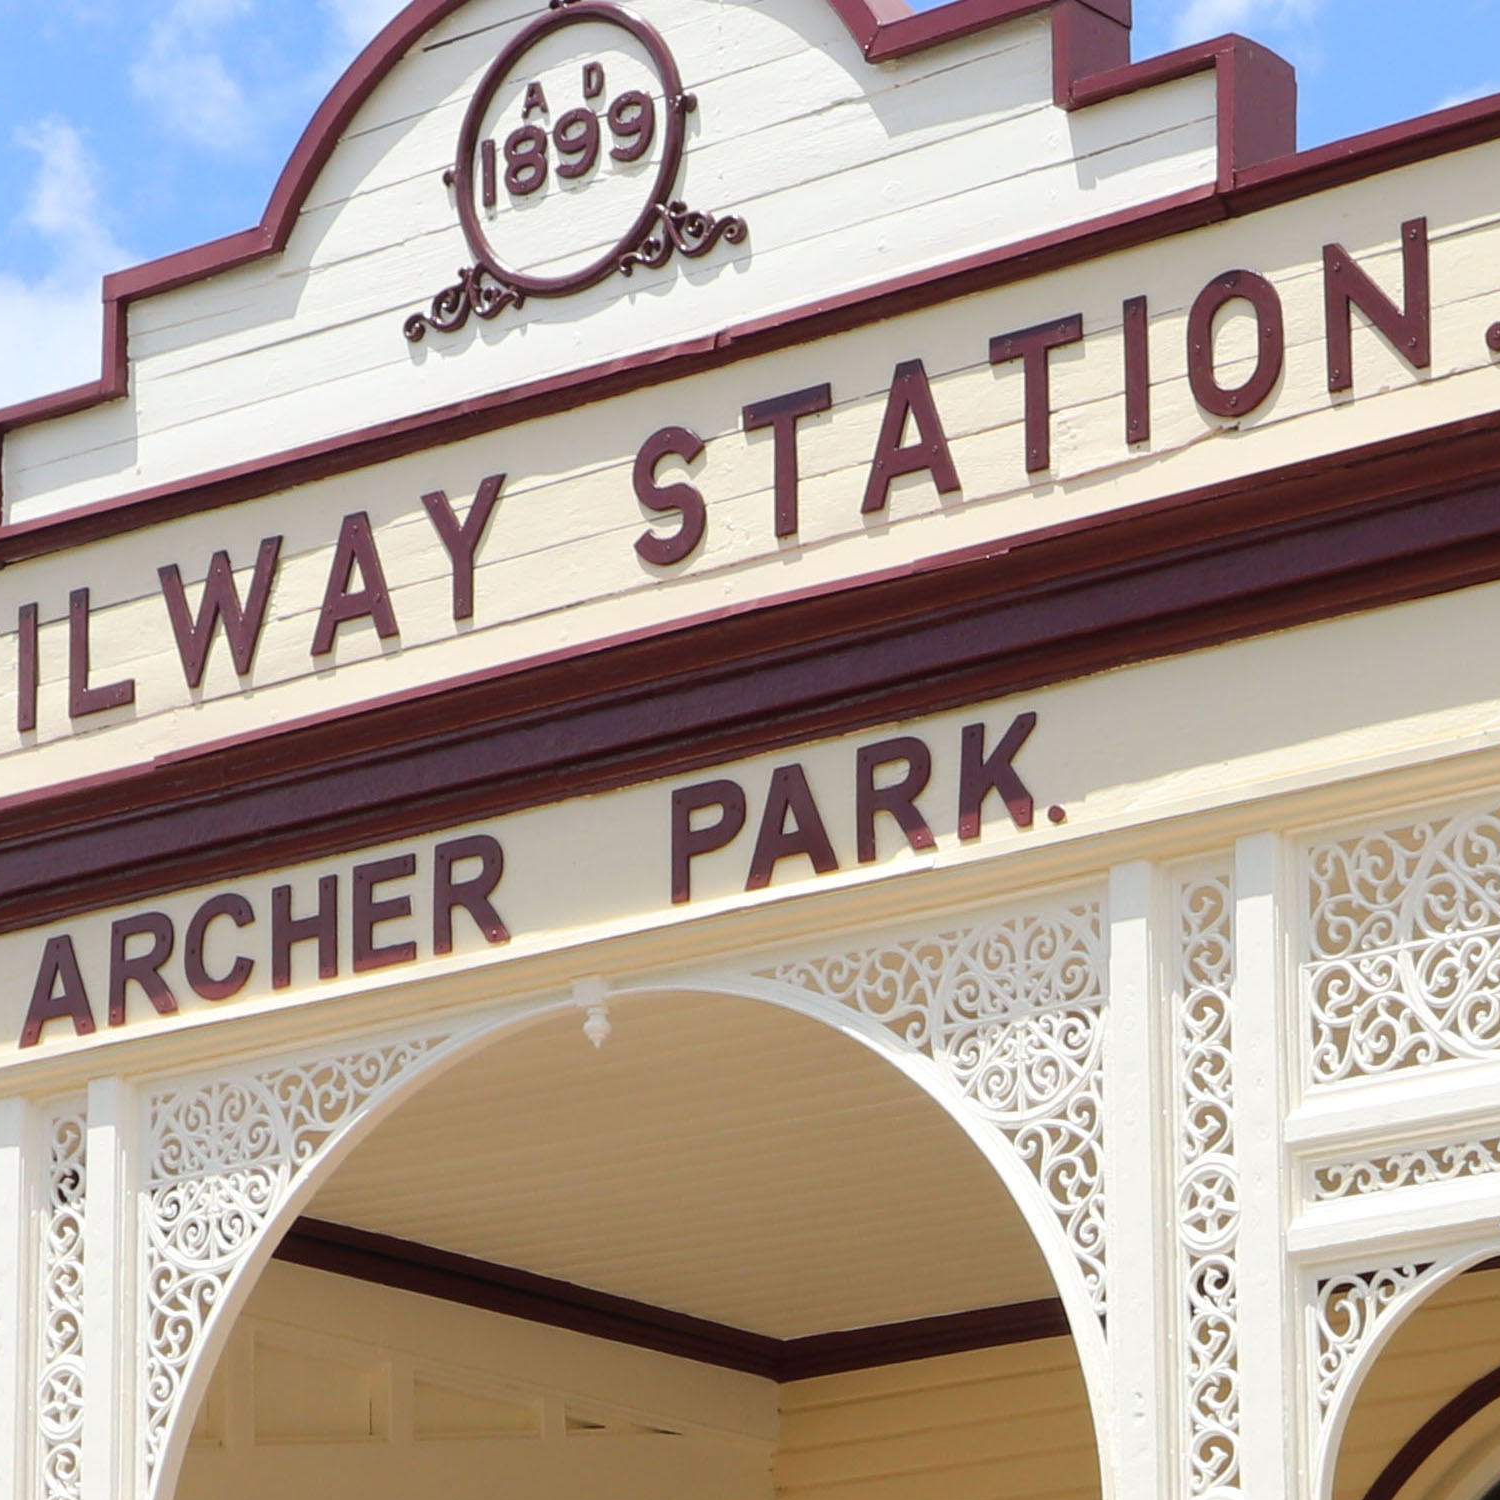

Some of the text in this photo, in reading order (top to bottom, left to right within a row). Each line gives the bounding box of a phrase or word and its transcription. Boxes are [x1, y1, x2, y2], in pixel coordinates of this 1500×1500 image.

[481, 90, 655, 208] 1899
[521, 61, 605, 119] A D
[19, 711, 1066, 1047] ARCHER PARK.
